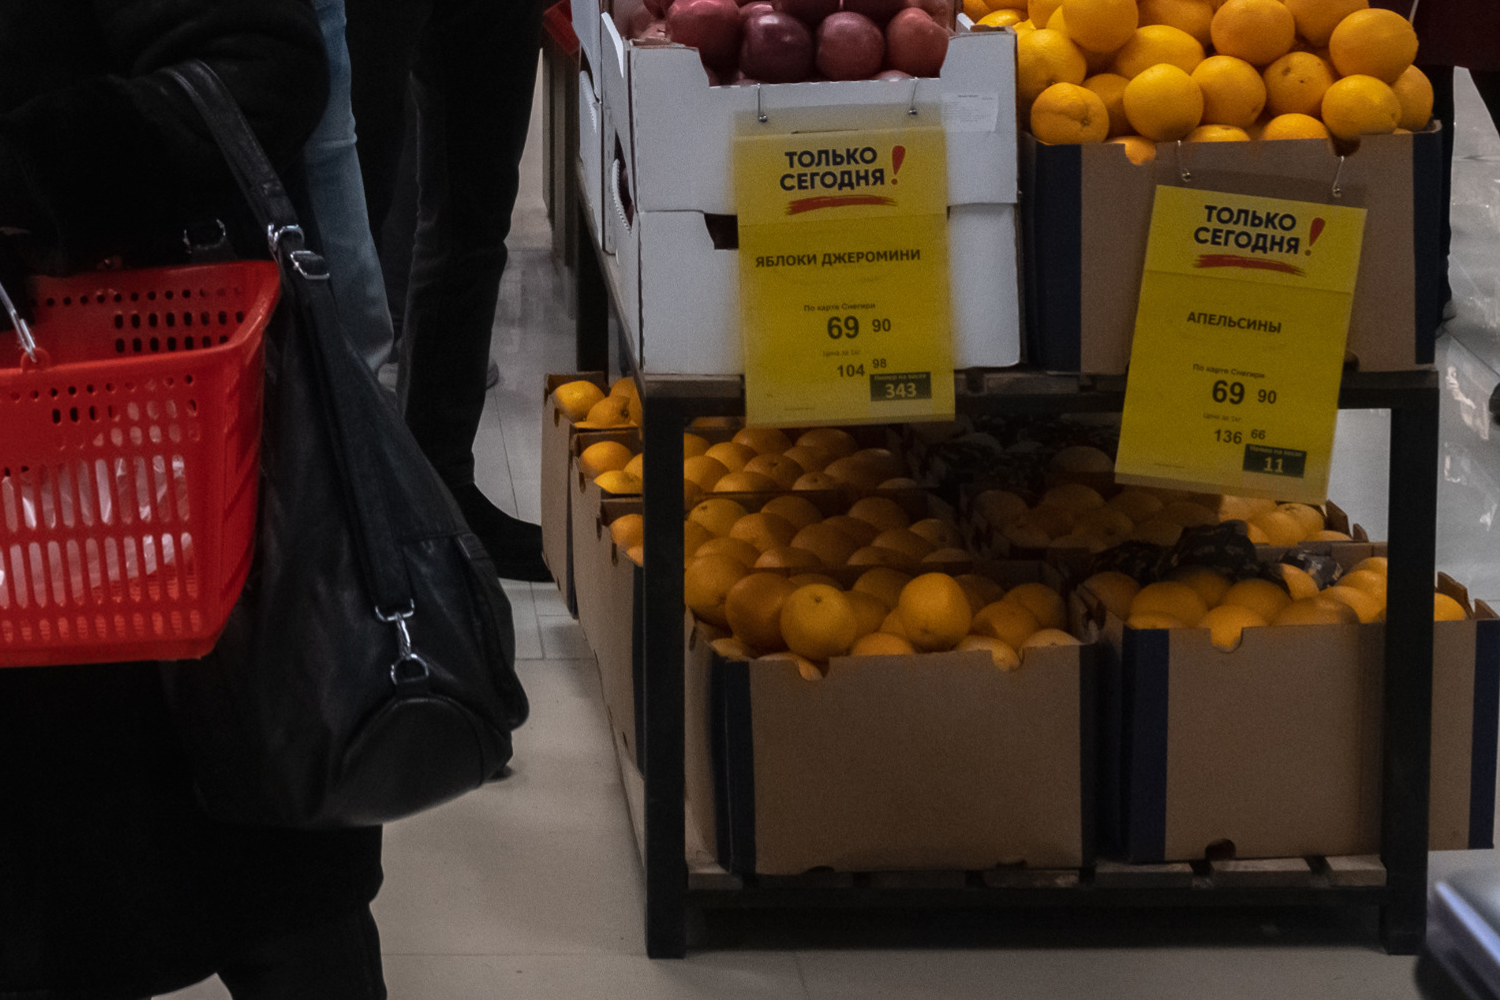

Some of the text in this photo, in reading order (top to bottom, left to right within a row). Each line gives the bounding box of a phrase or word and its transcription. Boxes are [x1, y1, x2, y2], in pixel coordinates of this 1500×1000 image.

[784, 146, 877, 169] ТОЛЬКО
[1204, 205, 1296, 231] ТОЛЬКО
[755, 249, 921, 268] ЯБЛОКИ ДЖЕРОМИНИ
[827, 315, 891, 340] 69 90
[1186, 311, 1282, 333] АПЕЛЬСИНЫ
[836, 358, 887, 378] 104 98
[884, 382, 917, 399] 343
[1212, 379, 1277, 405] 69 90
[1213, 429, 1266, 444] 136 66
[1263, 456, 1284, 474] 11
